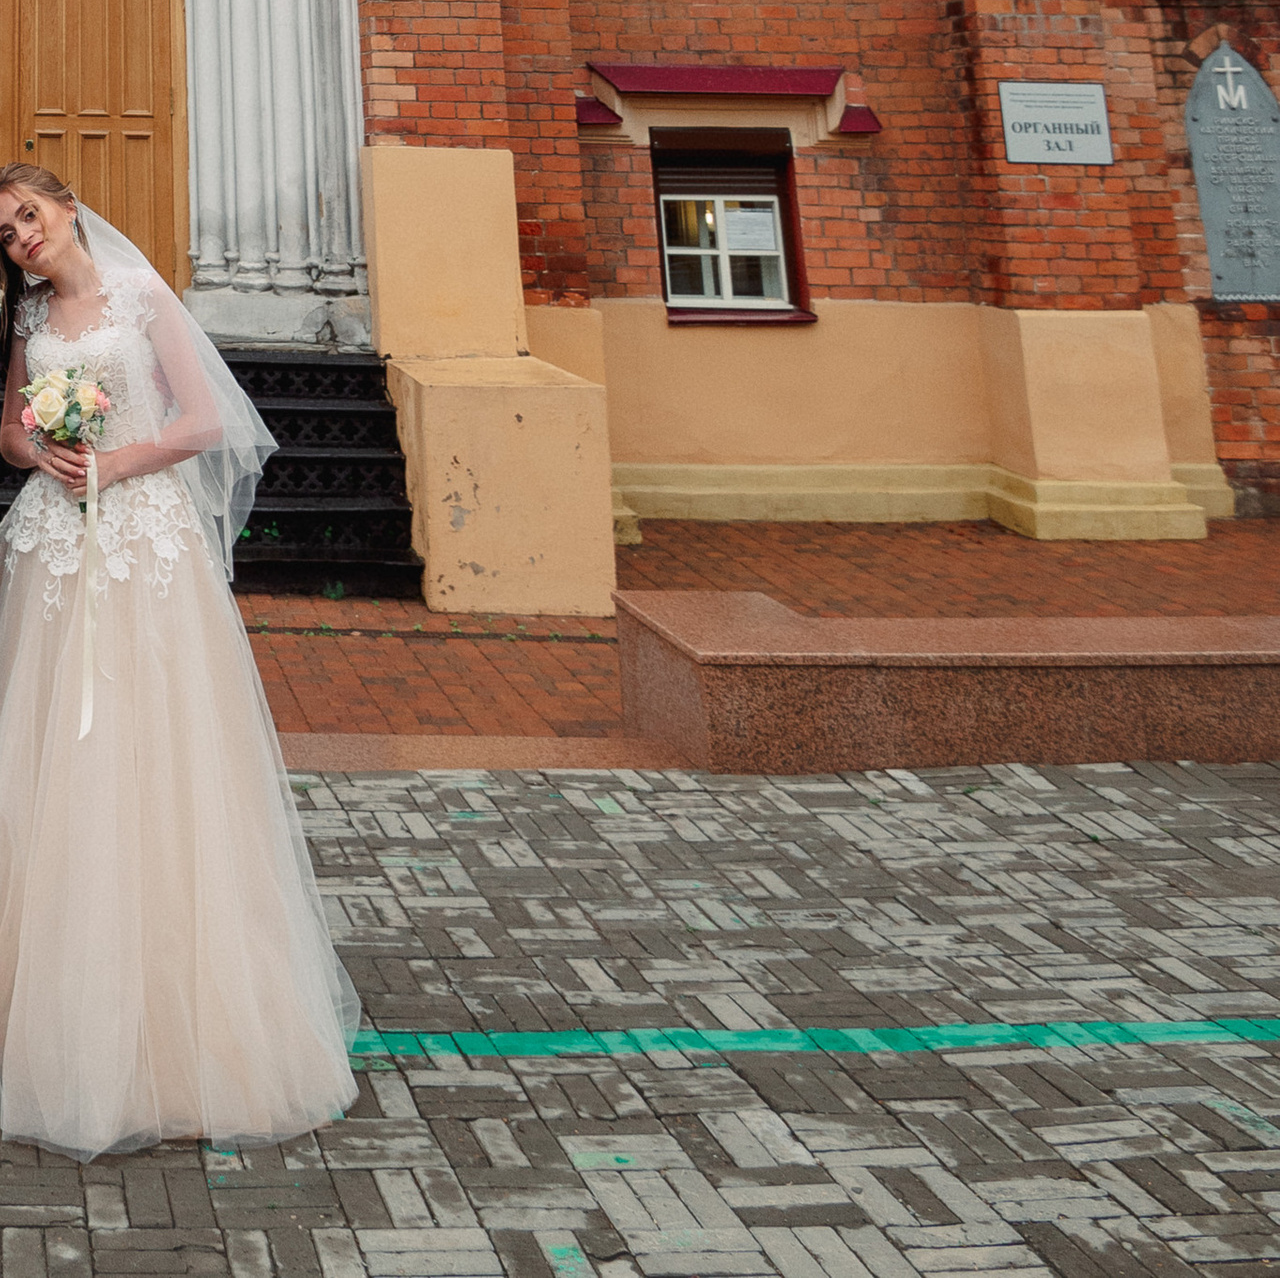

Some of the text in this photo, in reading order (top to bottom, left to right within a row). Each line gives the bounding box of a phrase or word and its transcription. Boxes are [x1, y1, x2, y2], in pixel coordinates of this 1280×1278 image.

[1011, 120, 1101, 135] ОРГАННЫЙ
[1043, 139, 1074, 152] ЗАЛ
[1229, 204, 1269, 213] CHRCH
